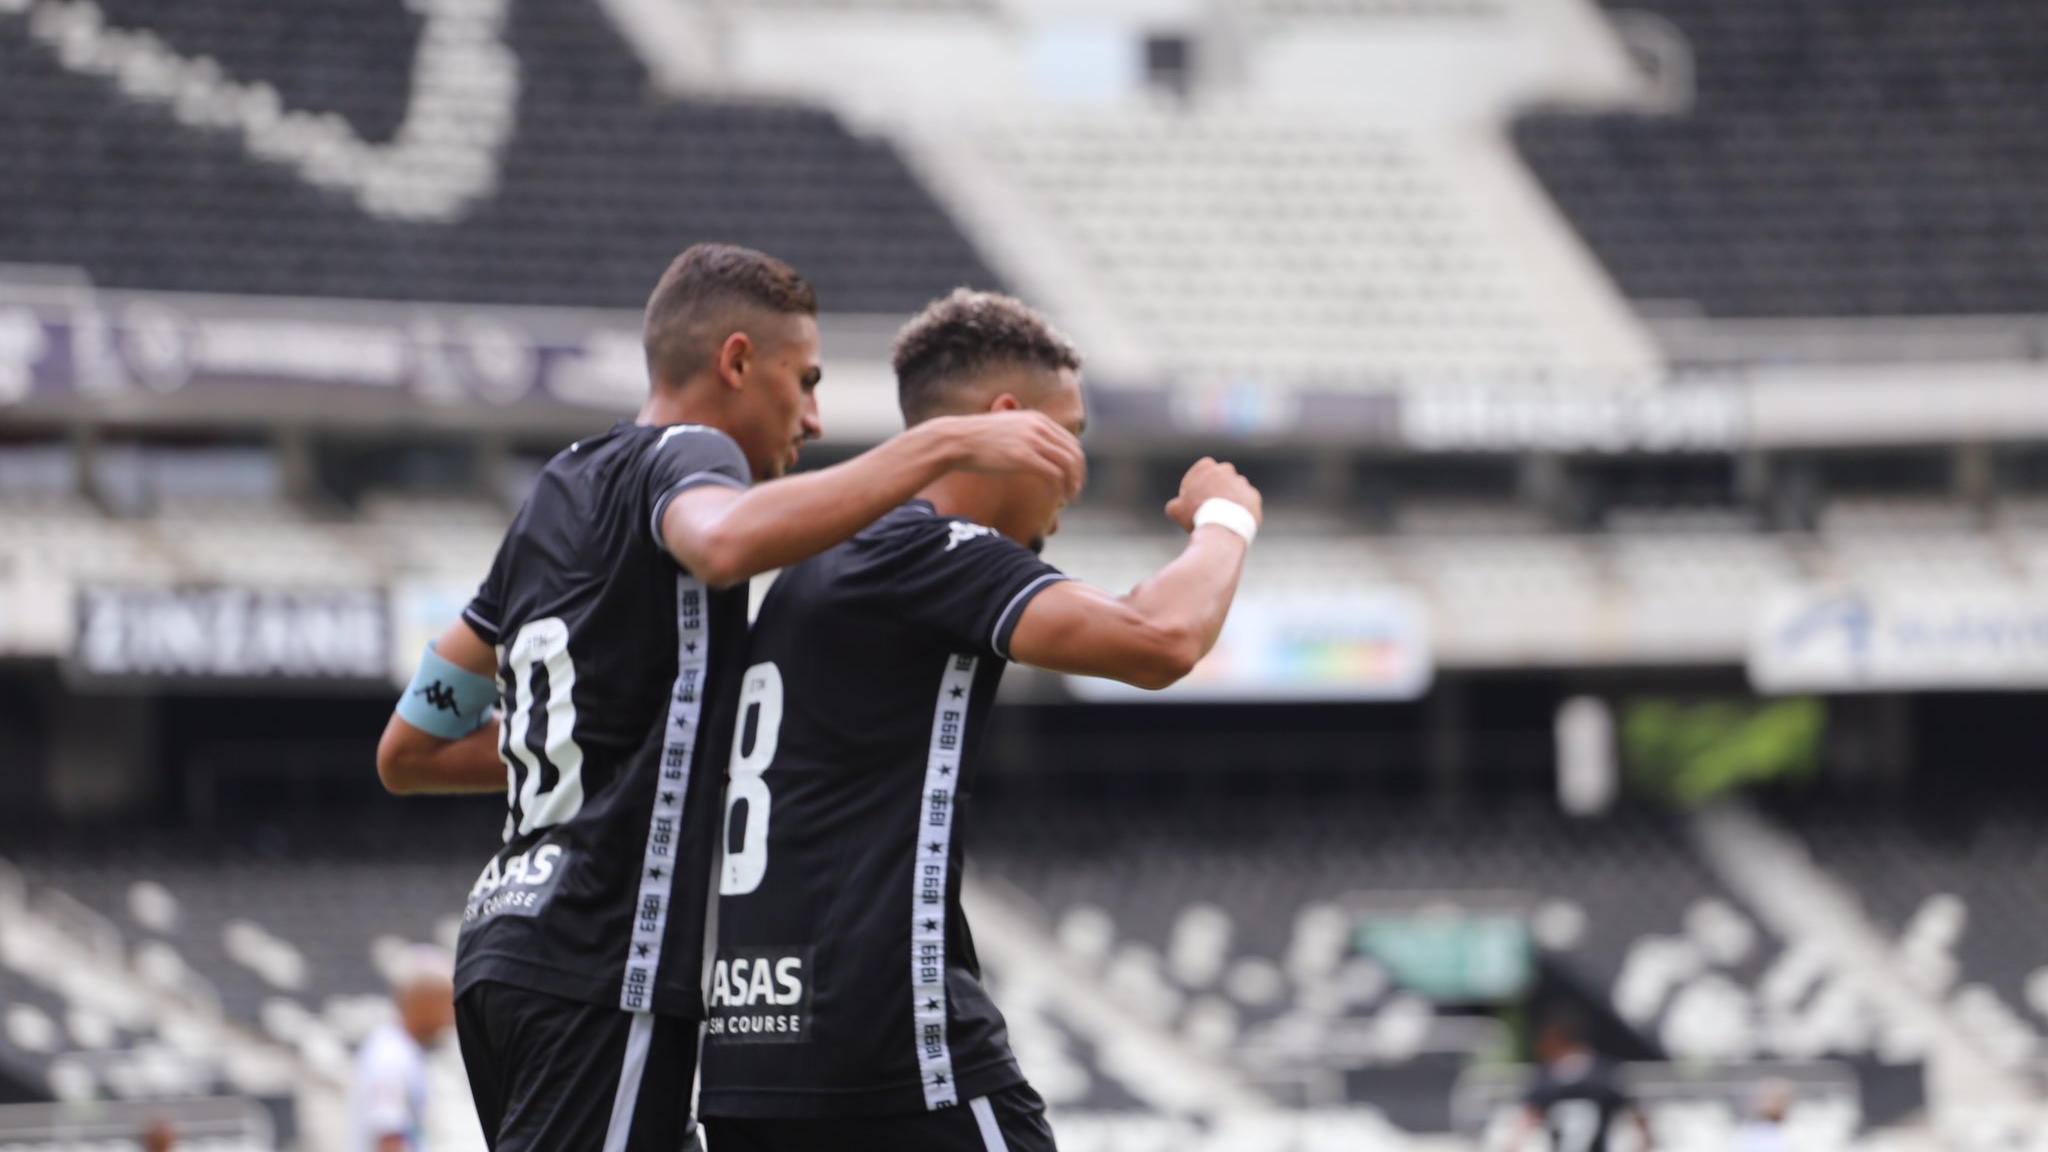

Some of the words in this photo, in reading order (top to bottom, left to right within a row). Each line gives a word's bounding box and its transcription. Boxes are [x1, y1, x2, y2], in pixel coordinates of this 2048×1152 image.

[940, 711, 959, 750] 1899
[664, 741, 685, 780] 1899
[930, 789, 948, 826] 1899
[923, 865, 940, 904] 1899
[710, 955, 801, 1008] ASAS
[921, 945, 937, 983] 1899
[626, 967, 648, 1008] 1899
[728, 1015, 800, 1033] COURSE
[924, 1024, 941, 1059] 1899
